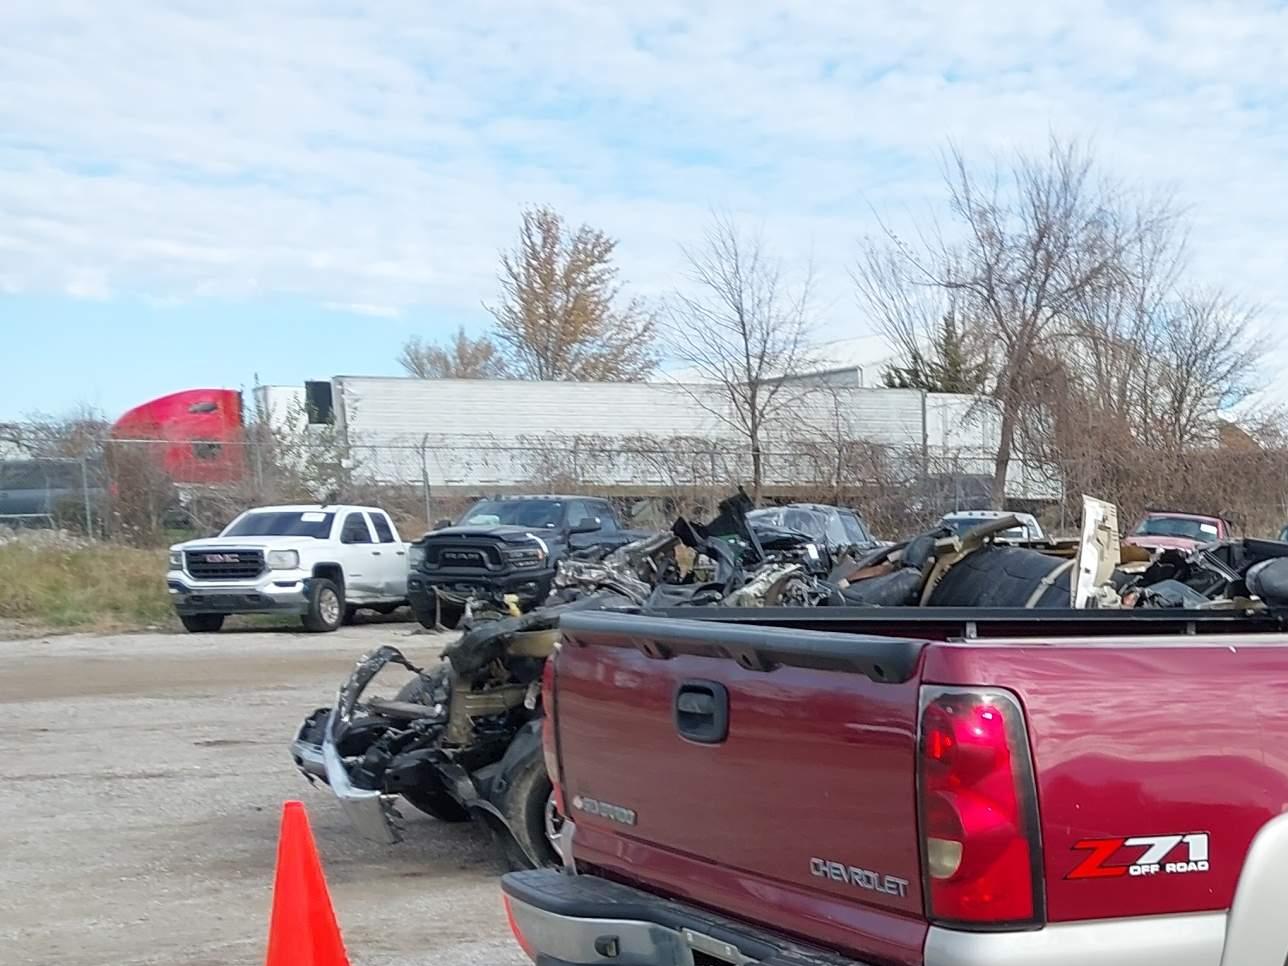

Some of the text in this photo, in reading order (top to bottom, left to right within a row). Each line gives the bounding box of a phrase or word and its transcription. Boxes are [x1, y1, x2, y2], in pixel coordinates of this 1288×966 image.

[444, 552, 480, 561] RAM
[1064, 832, 1209, 880] Z71
[1129, 861, 1210, 877] OFF ROAD
[809, 857, 909, 897] CHEVROLET
